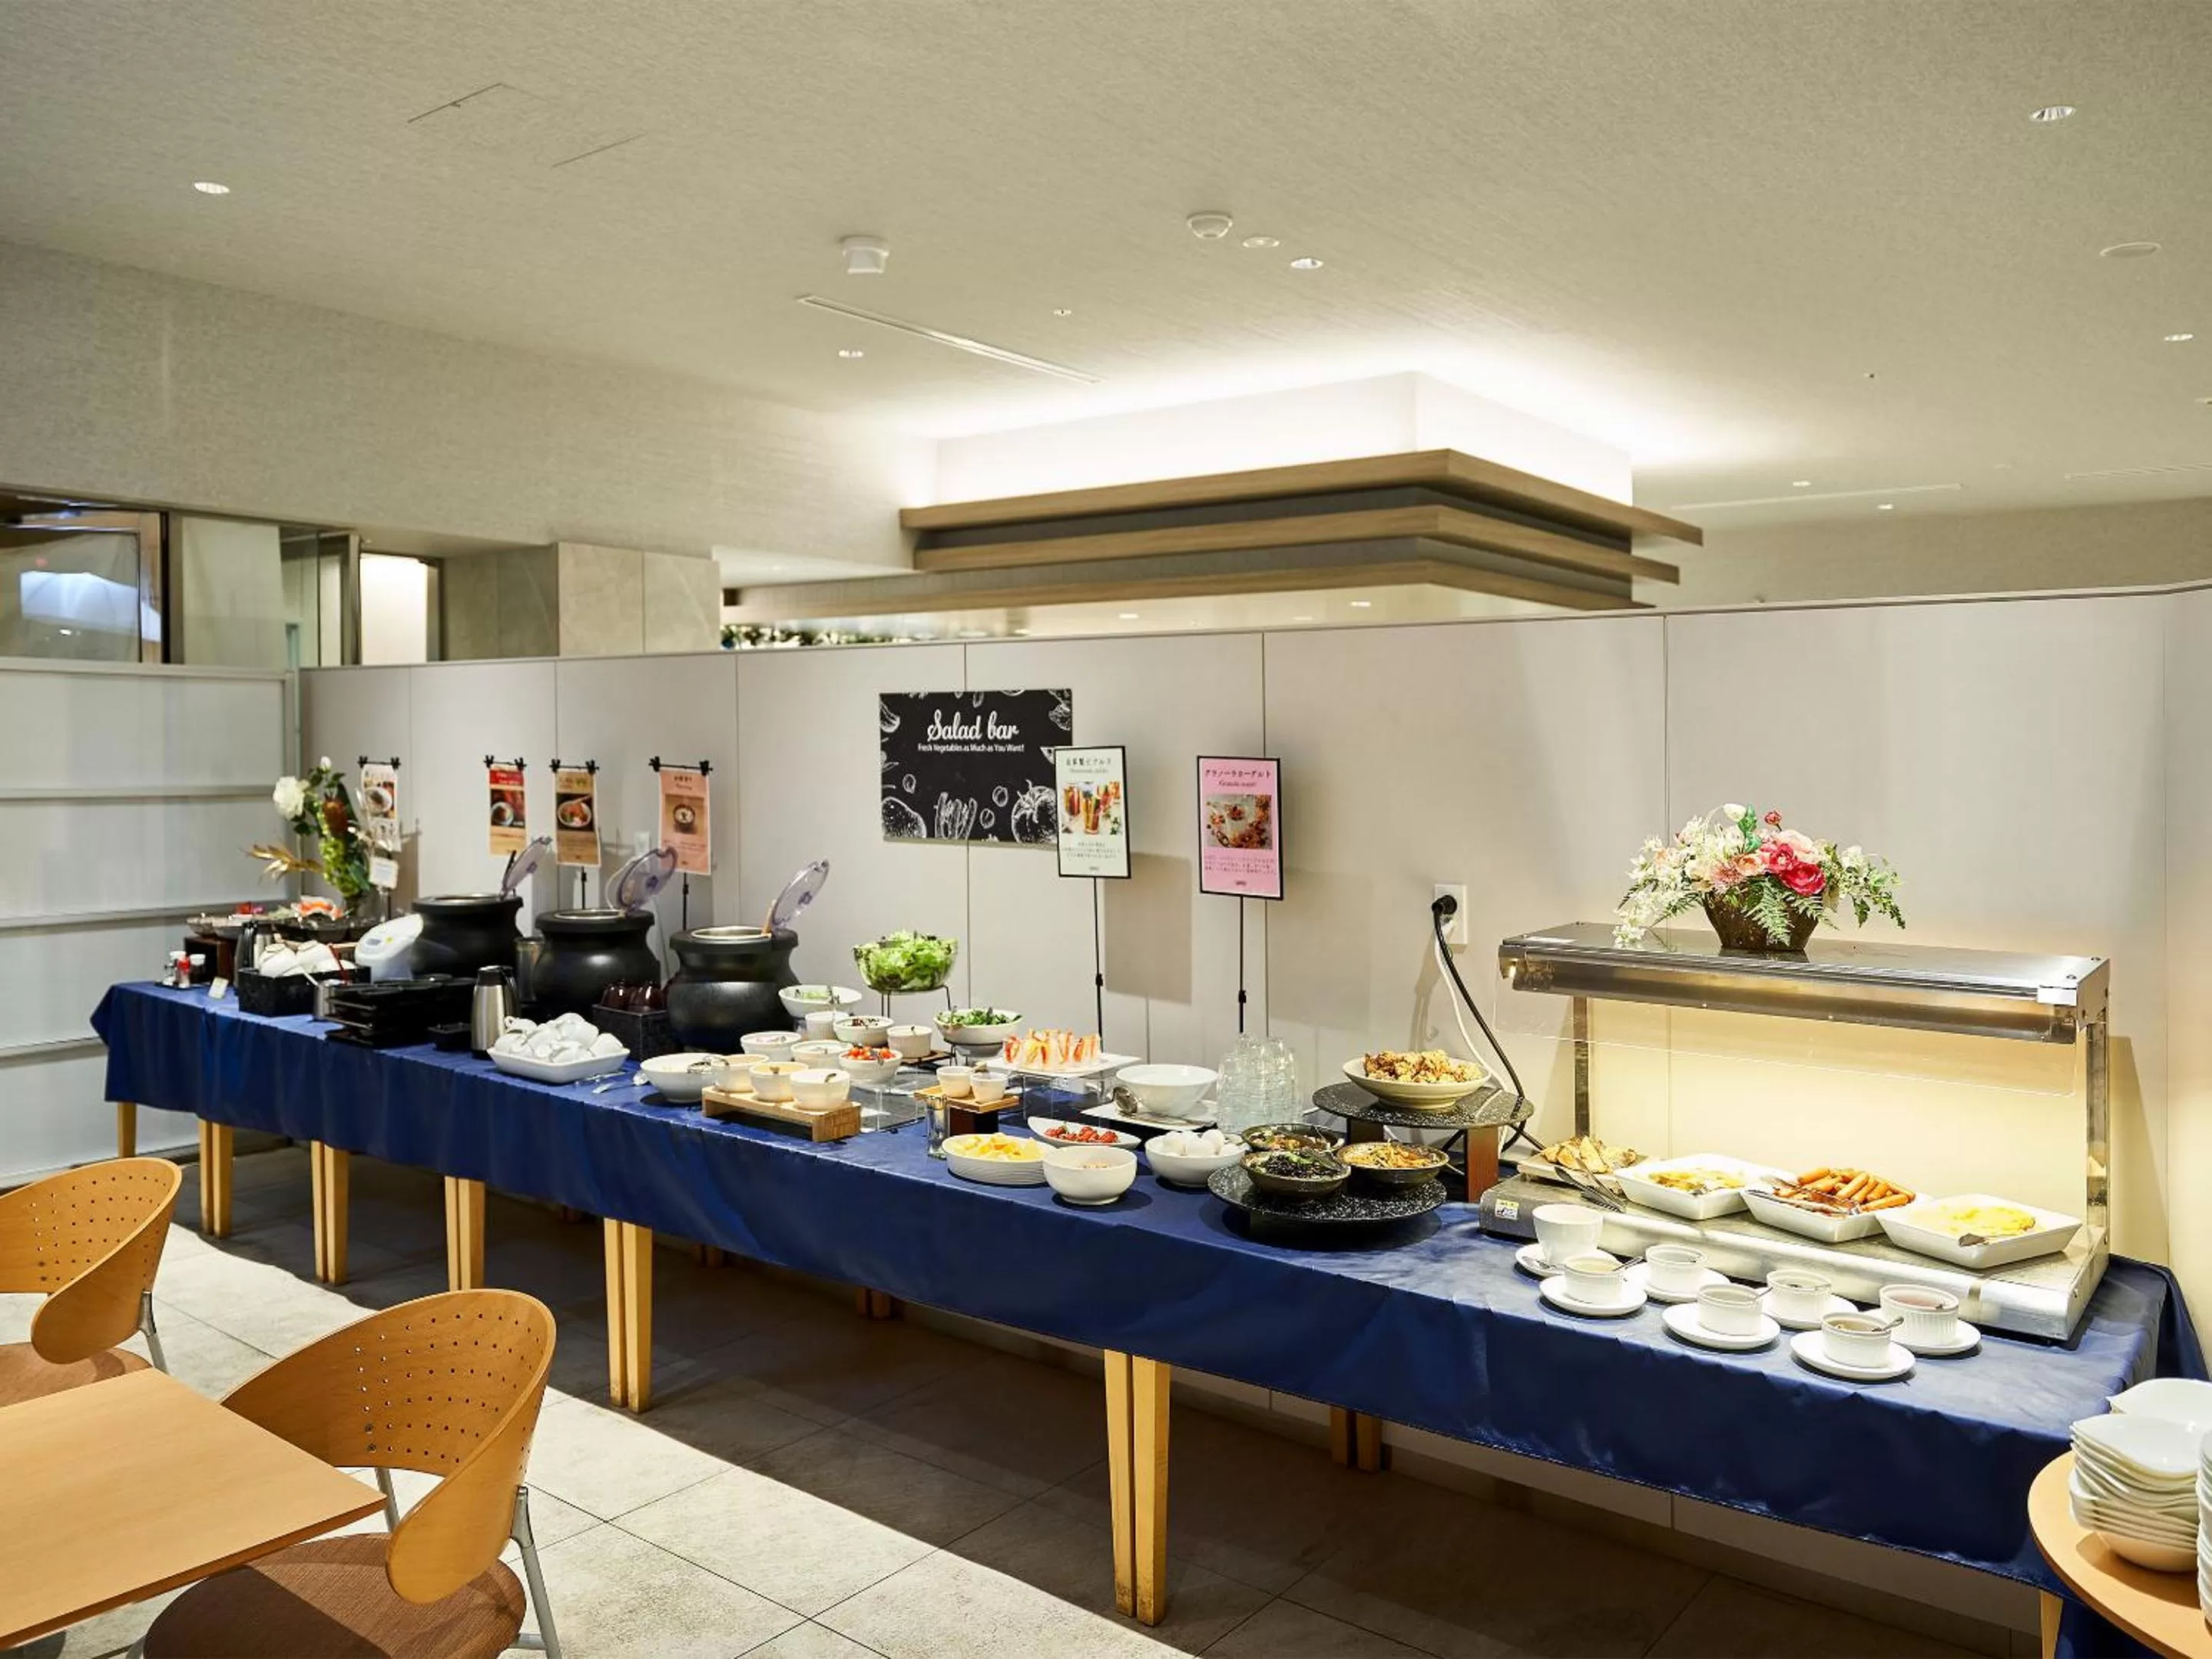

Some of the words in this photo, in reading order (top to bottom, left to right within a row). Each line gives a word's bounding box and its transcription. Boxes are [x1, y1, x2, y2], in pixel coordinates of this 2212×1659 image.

[927, 709, 982, 742] Salad
[988, 710, 1020, 740] bar
[918, 743, 932, 752] Fresh
[933, 743, 962, 753] Vegetables
[971, 743, 986, 752] Much
[995, 743, 1006, 753] You
